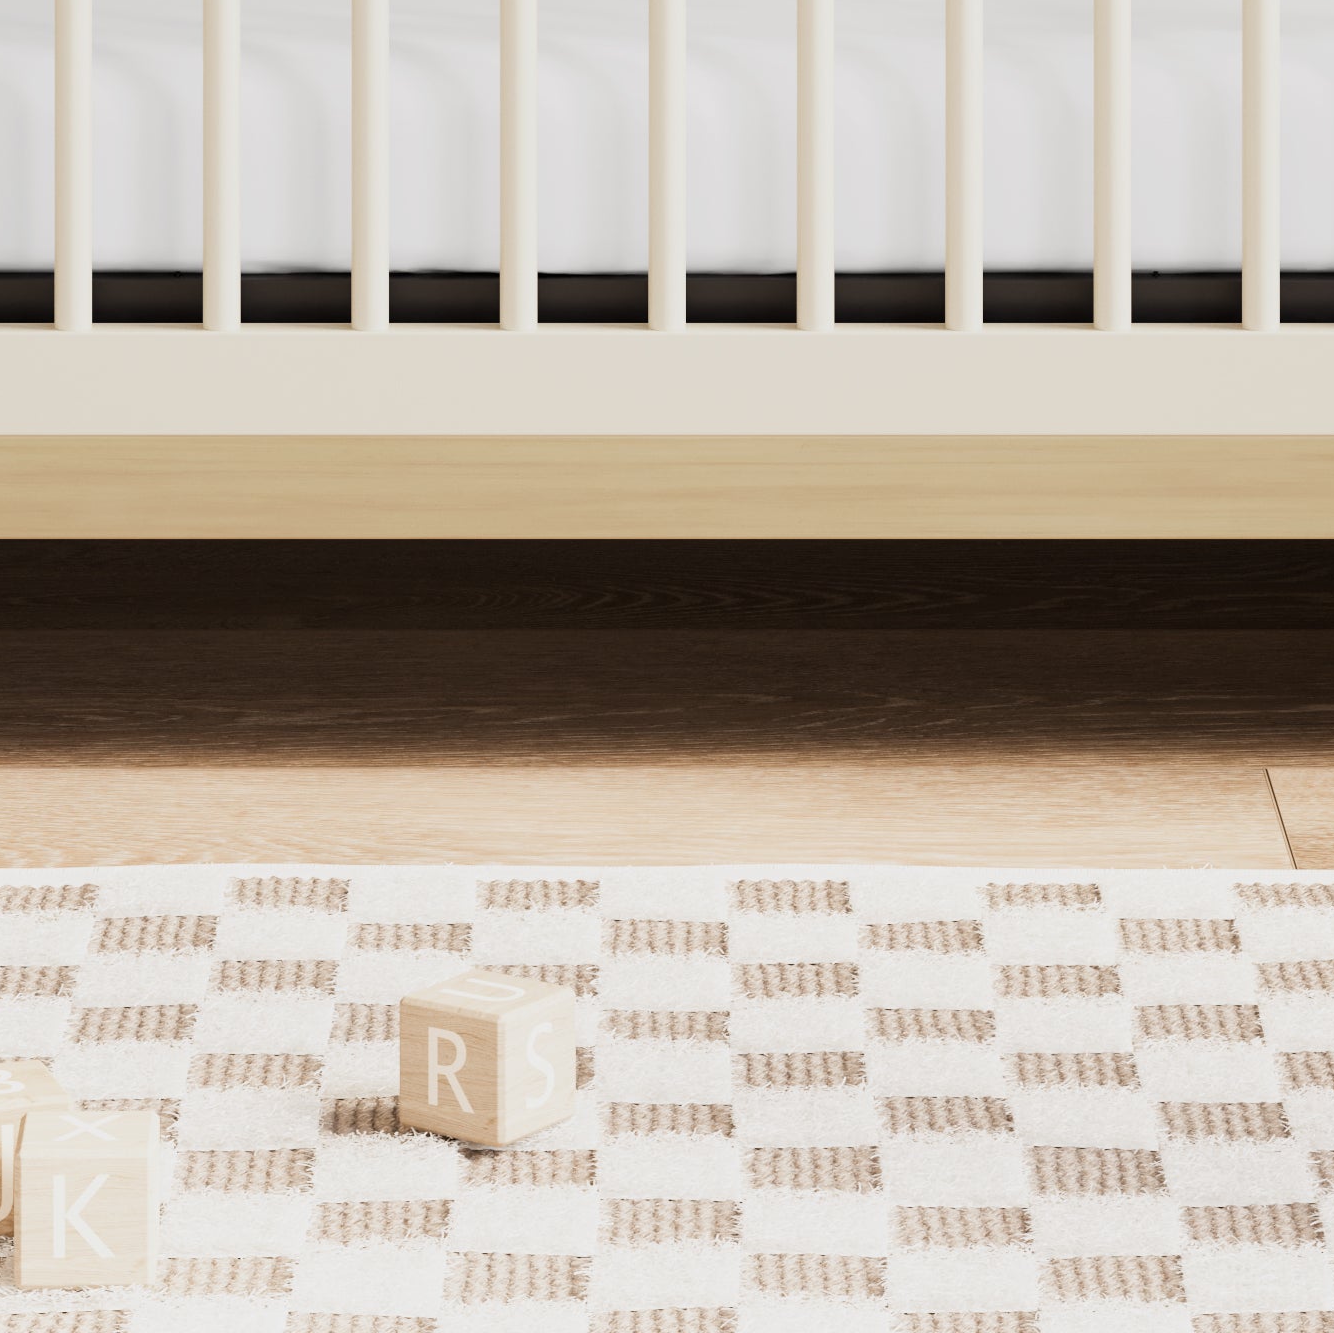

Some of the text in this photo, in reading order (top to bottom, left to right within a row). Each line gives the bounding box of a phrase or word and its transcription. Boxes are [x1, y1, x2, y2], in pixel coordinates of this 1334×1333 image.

[440, 978, 526, 1002] U
[428, 1026, 475, 1114] R
[525, 1022, 555, 1109] S
[53, 1114, 121, 1141] X
[52, 1173, 116, 1259] K
